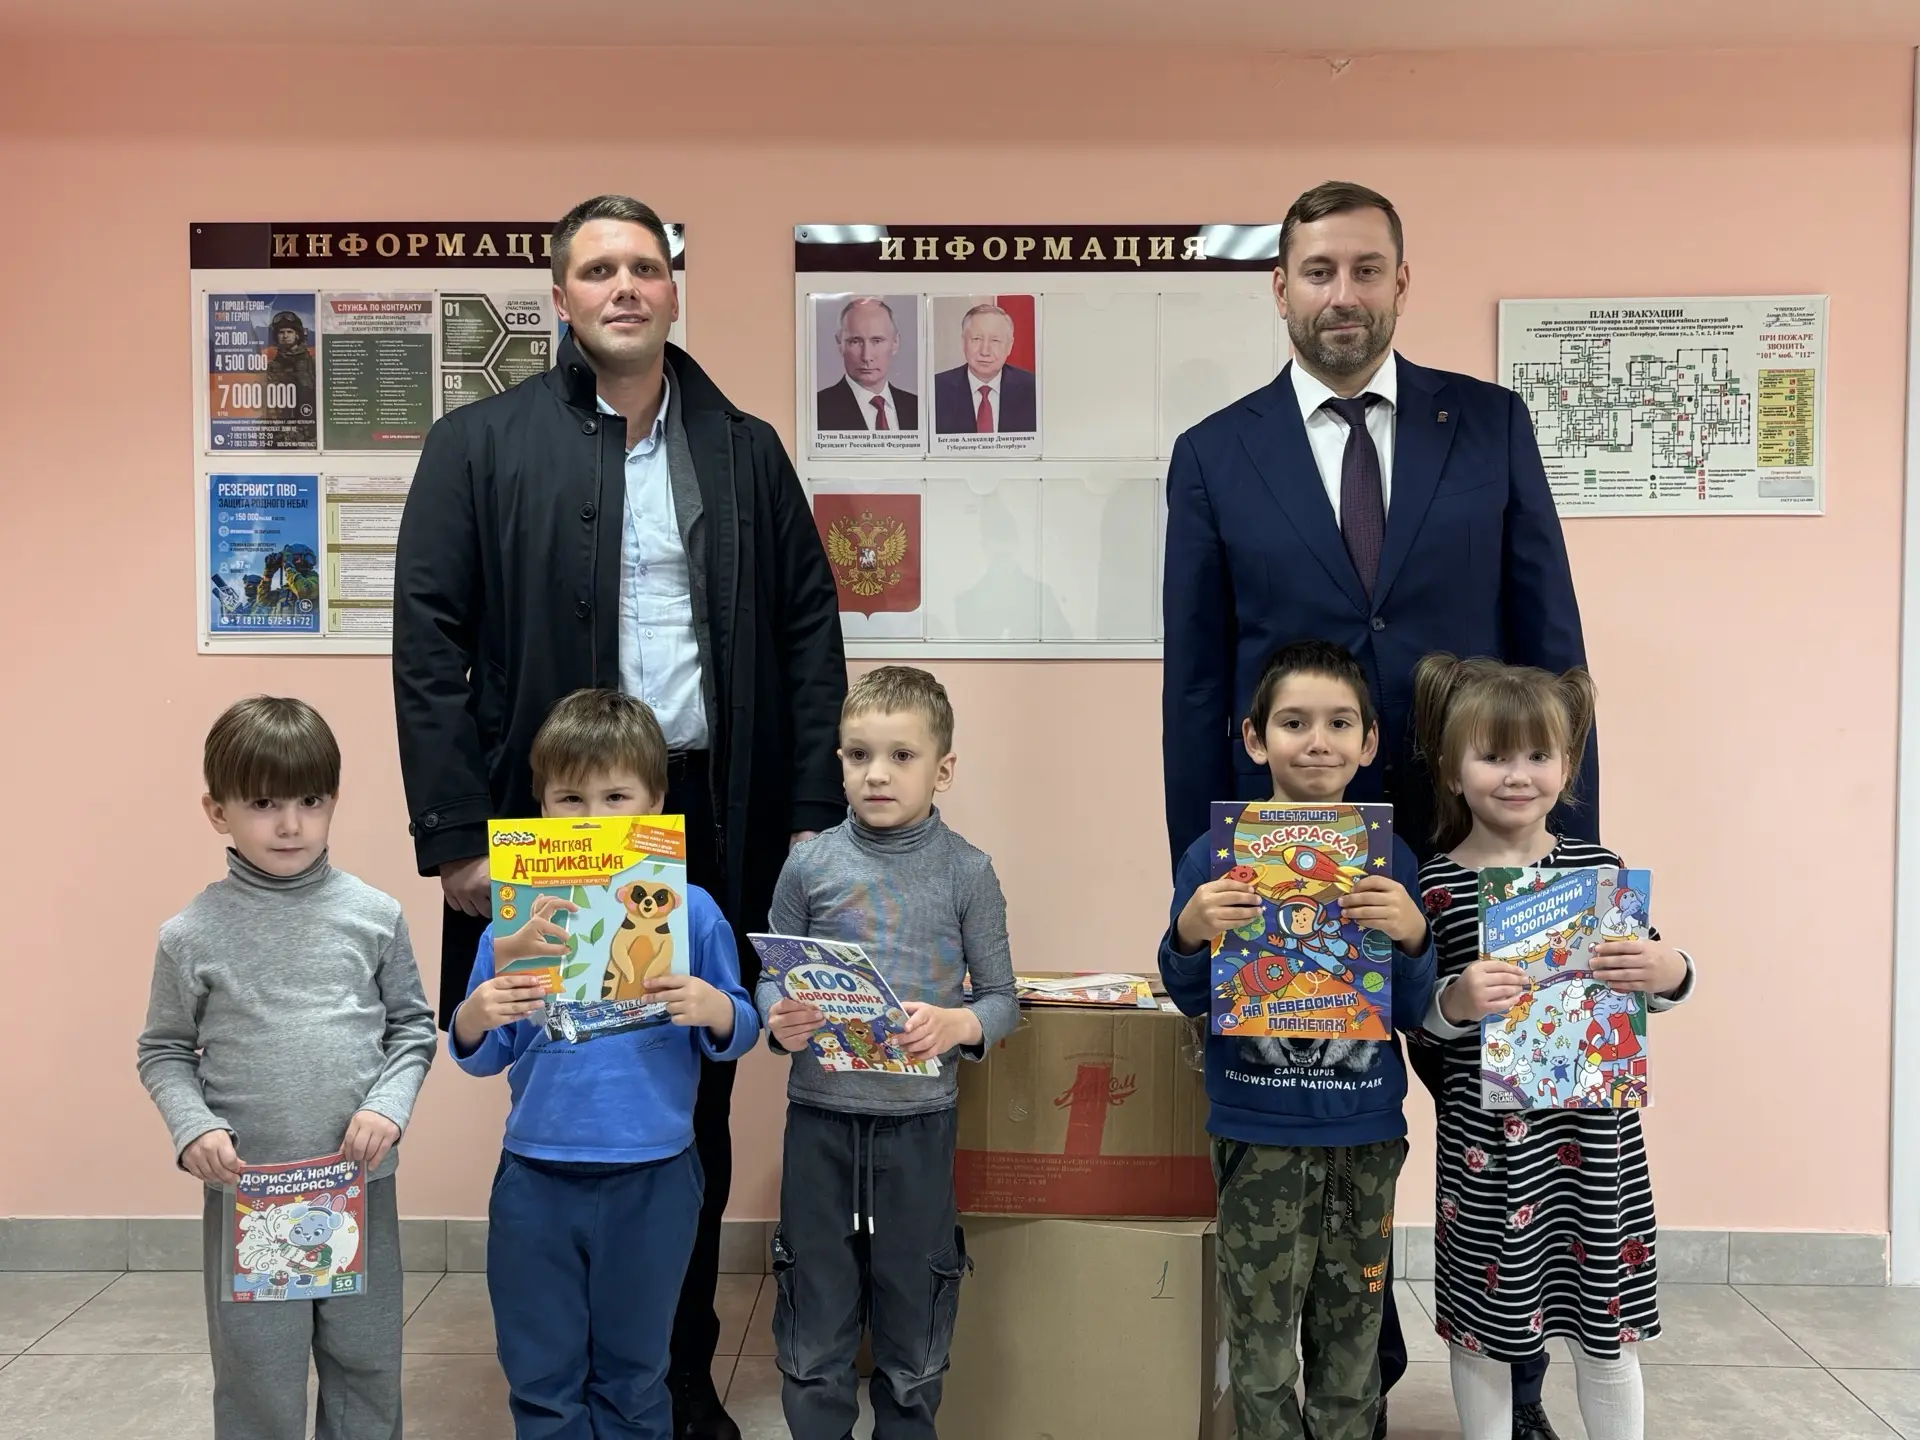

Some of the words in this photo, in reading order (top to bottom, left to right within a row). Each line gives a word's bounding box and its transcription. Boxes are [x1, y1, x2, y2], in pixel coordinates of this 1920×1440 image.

[879, 235, 1207, 267] ИНФОРМАЦИЯ
[338, 304, 368, 312] СЛУЖБА
[382, 303, 422, 311] КОНТРАКТУ
[444, 302, 460, 316] 01
[1590, 310, 1619, 318] ПЛАН
[1622, 309, 1684, 318] ЭВАКУАЦИИ
[504, 313, 540, 325] СВО
[215, 332, 229, 346] 210
[232, 332, 248, 346] 000
[530, 341, 547, 355] 02
[215, 354, 222, 370] 4
[225, 354, 244, 370] 500
[248, 354, 268, 370] 000
[444, 375, 462, 390] 03
[218, 384, 230, 408] 7
[232, 383, 262, 408] 000
[267, 383, 296, 408] 000
[218, 484, 274, 496] РЕЗЕРВИСТ
[277, 484, 296, 496] ПВО
[219, 499, 250, 508] ЗАЩИТА
[252, 499, 285, 508] РОДНОГО
[287, 499, 308, 508] НЕБА!
[231, 617, 240, 625] +7
[244, 617, 265, 625] (812)
[268, 617, 310, 625] 572-51-72
[539, 838, 592, 854] Мягкая
[1248, 826, 1358, 860] РАСКРАСКА
[512, 853, 624, 879] Аппликация
[1502, 883, 1582, 930] НОВОГОДНИЙ
[1514, 905, 1569, 937] ЗООПАРК
[802, 970, 857, 995] 100
[796, 992, 883, 1004] НОВОГОДНИХ
[1242, 1004, 1262, 1017] НА
[1267, 992, 1358, 1014] НЕВЕДОМЫХ
[820, 1004, 876, 1016] ЗАДАЧЕК
[1268, 1018, 1346, 1031] ПЛАНЕТАХ
[1274, 1067, 1305, 1075] CANIS
[1308, 1068, 1335, 1077] LUPUS
[1225, 1069, 1297, 1087] YELLOWSTONE
[1301, 1078, 1356, 1090] NATIONAL
[1360, 1077, 1383, 1089] PARK
[240, 1169, 306, 1185] ДОРИСУЙ,
[308, 1161, 358, 1180] НАКЛЕЙ,
[266, 1179, 335, 1195] РАСКРАСЬ
[336, 1279, 352, 1288] 50
